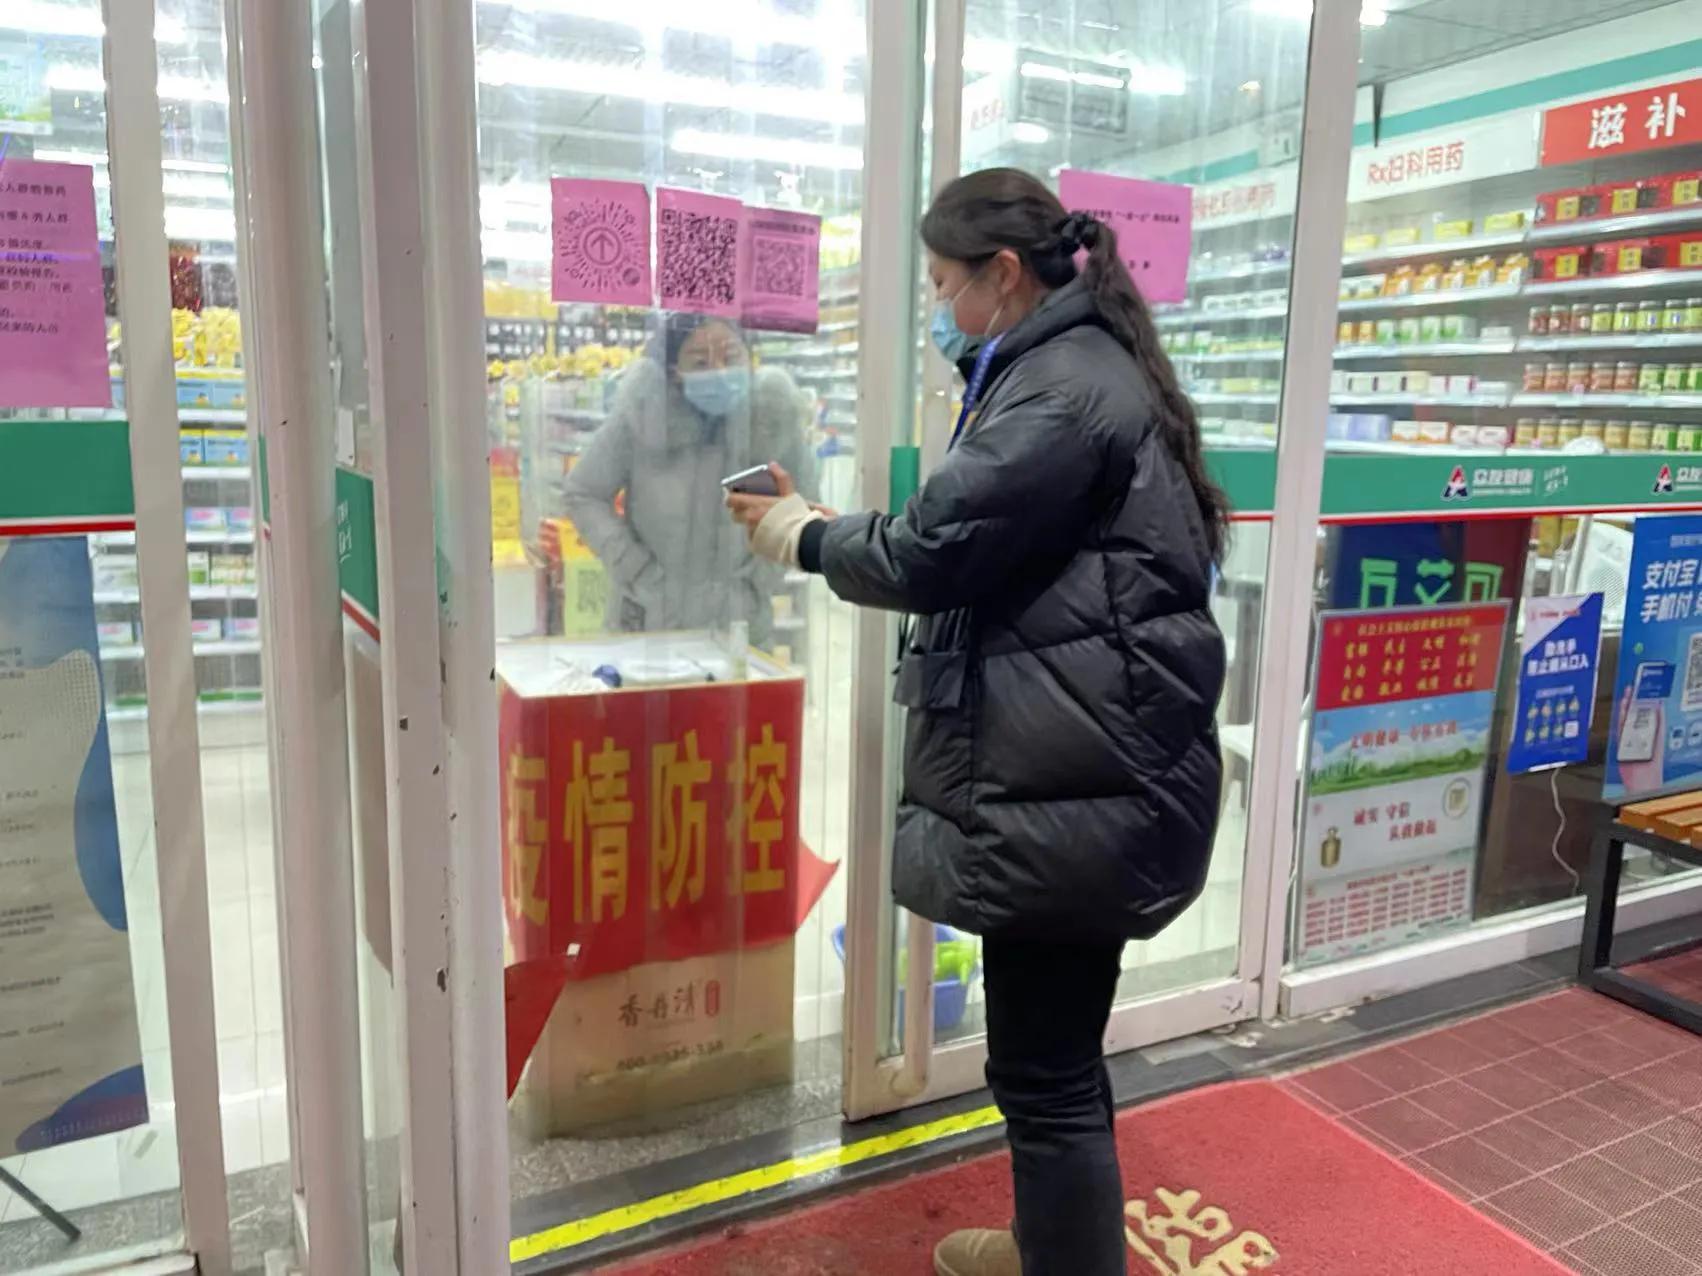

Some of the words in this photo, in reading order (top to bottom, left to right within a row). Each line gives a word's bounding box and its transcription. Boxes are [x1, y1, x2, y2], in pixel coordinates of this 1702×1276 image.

[1588, 92, 1686, 149] 滋补
[1367, 142, 1465, 184] Rx妇科用药
[507, 723, 787, 926] 疫情防控
